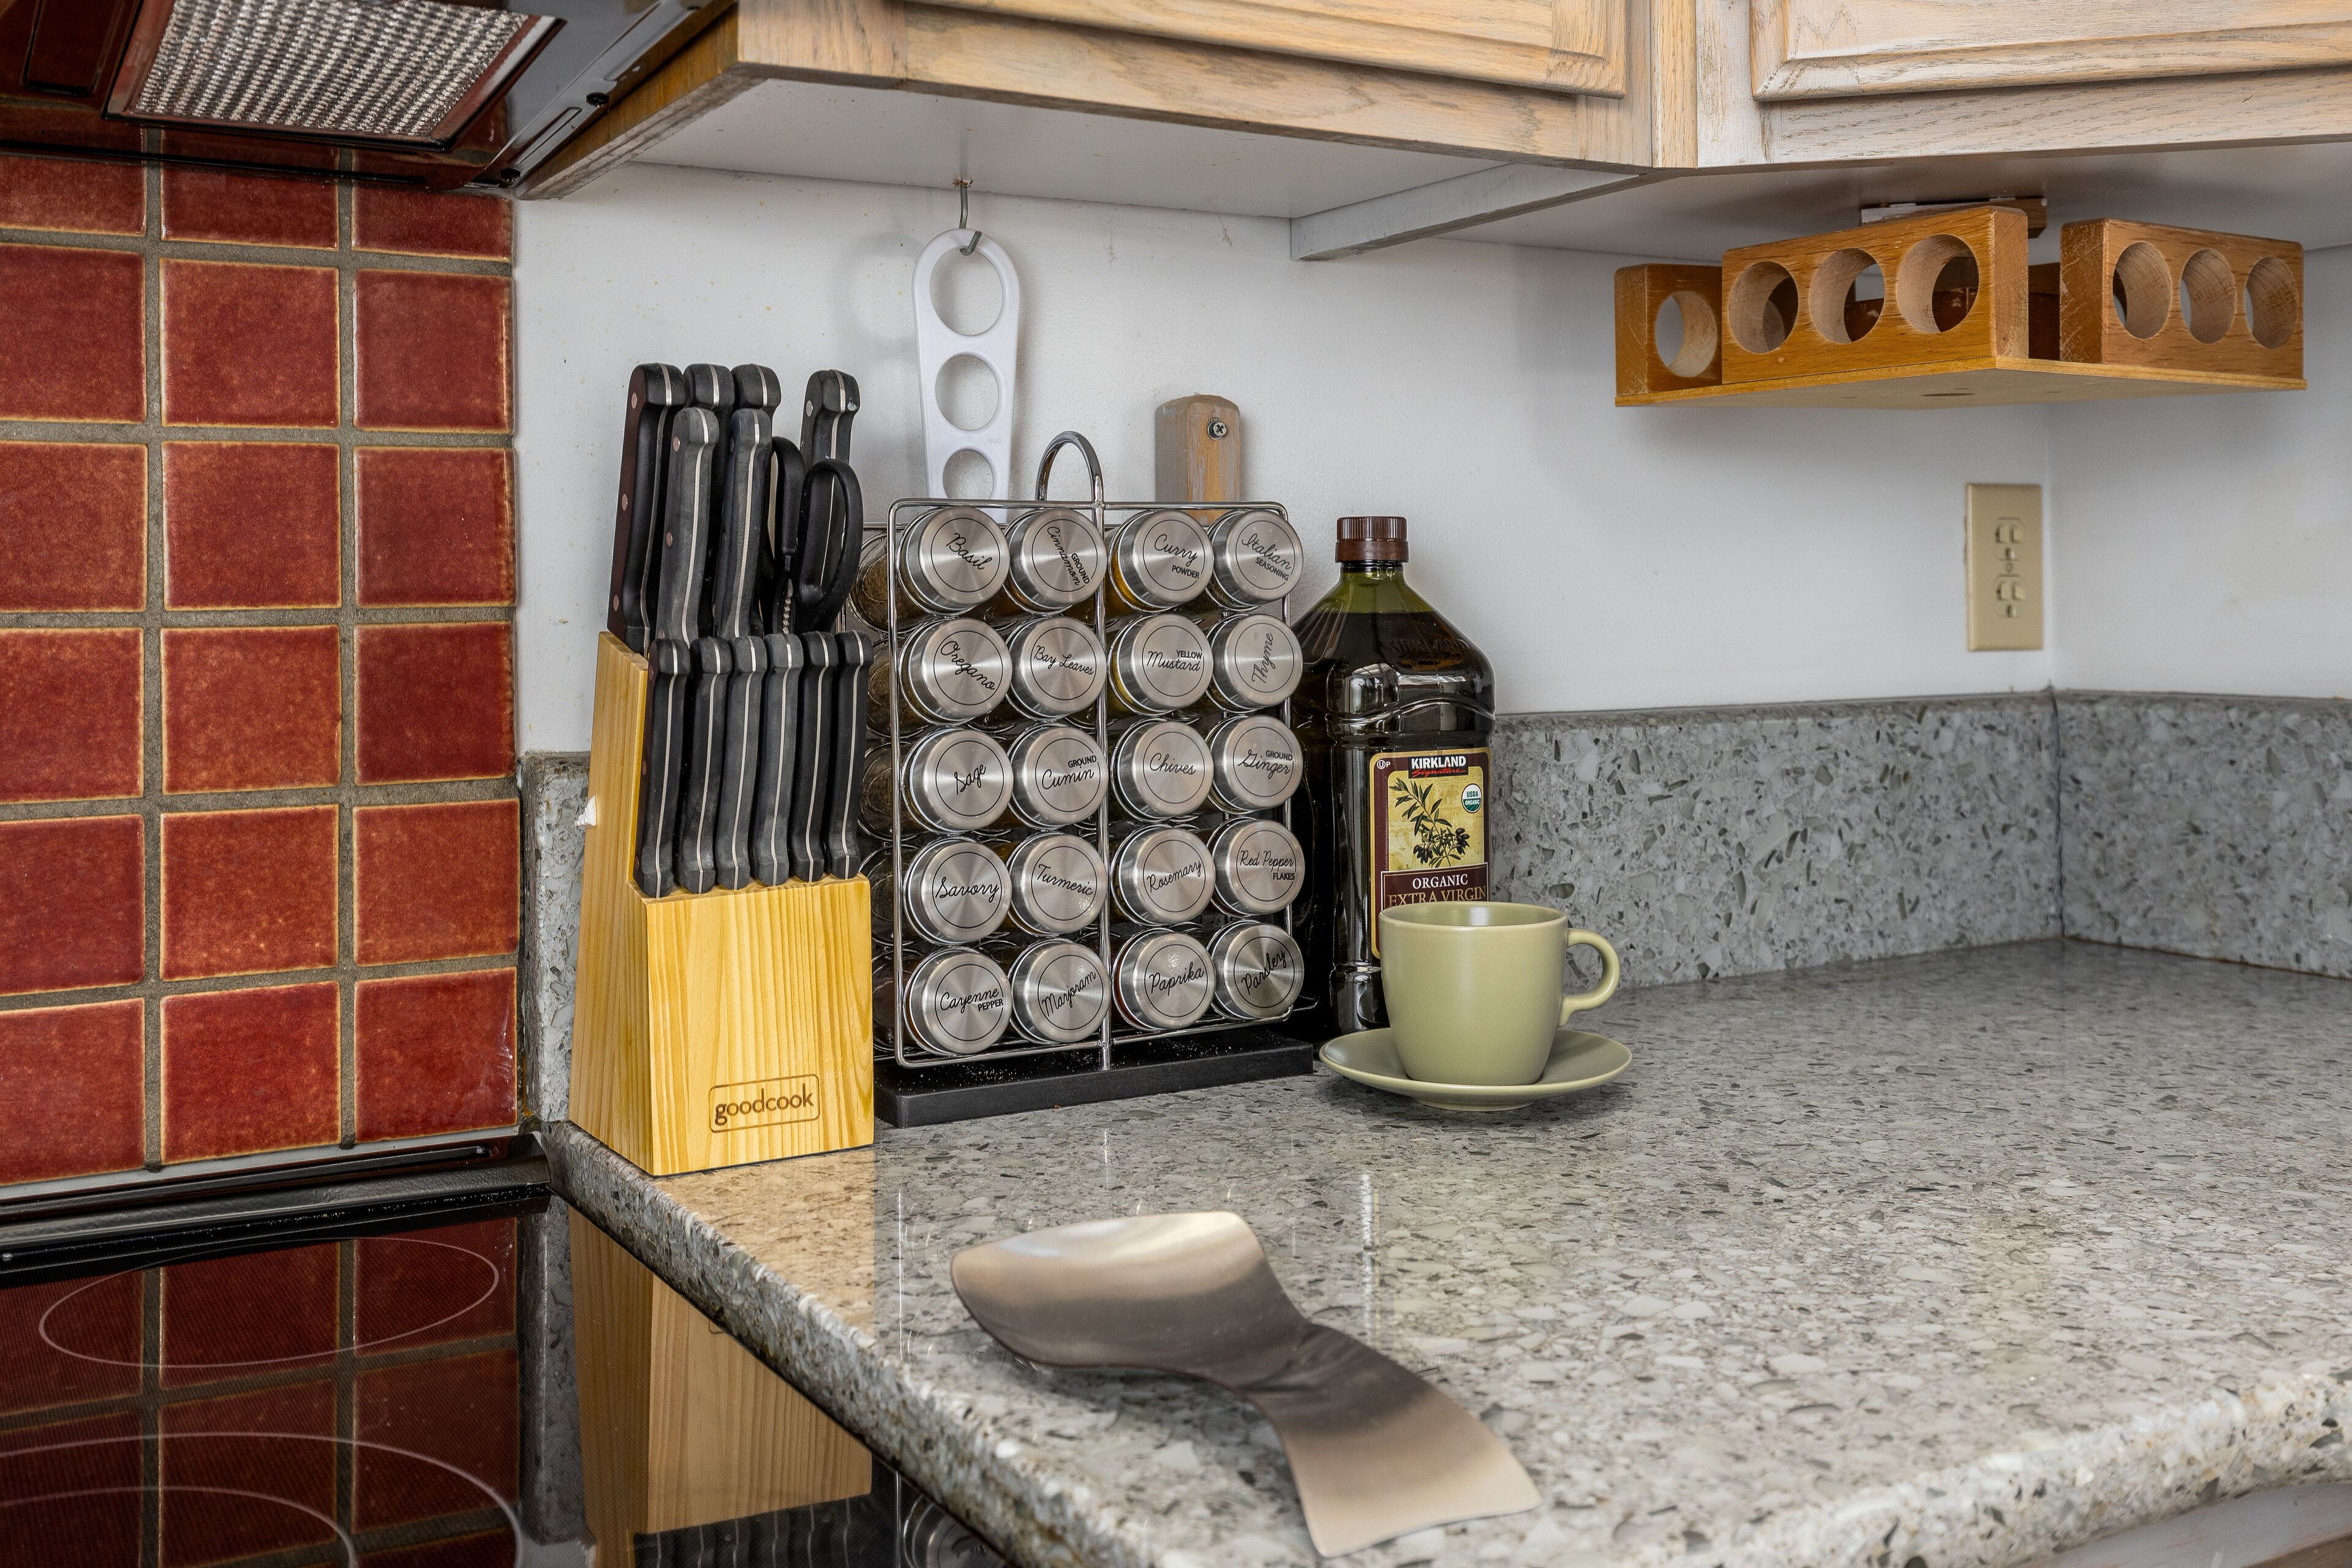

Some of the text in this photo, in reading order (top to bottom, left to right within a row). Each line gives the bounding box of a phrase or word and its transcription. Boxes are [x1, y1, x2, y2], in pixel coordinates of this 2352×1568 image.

[946, 533, 992, 570] Basil
[1047, 526, 1079, 586] Cinnamon
[1154, 534, 1197, 567] Curry
[1242, 533, 1291, 570] Italian
[1071, 553, 1090, 584] GROUND
[1172, 565, 1200, 579] POWDER
[1255, 557, 1289, 581] SEASONING
[940, 641, 995, 690] Oregano
[1034, 645, 1094, 675] Bay Leaves
[1147, 650, 1200, 671] Mustard
[1176, 650, 1202, 659] YELLOW
[1251, 631, 1276, 684] Thyme
[1068, 755, 1096, 768] GROUND
[1150, 752, 1196, 775] Chives
[1238, 749, 1291, 779] Ginger
[1265, 750, 1293, 761] GROUND
[1411, 756, 1466, 769] KIRKLAND
[954, 764, 986, 795] Sage
[1042, 766, 1095, 790] Cumin
[1412, 768, 1466, 778] Signature
[1240, 850, 1294, 872] Red Pepper
[935, 876, 999, 903] Savory
[1037, 864, 1093, 895] Turmeric
[1147, 861, 1202, 893] Rosemary
[1412, 873, 1468, 889] ORGANIC
[1387, 887, 1486, 908] EXTRA VIRGIN
[1149, 962, 1204, 996] Paprika
[1241, 950, 1286, 995] Parsley
[940, 988, 999, 1014] Cayenne
[978, 999, 1003, 1012] PEPPER
[1042, 971, 1096, 1017] Marjoram
[715, 1083, 814, 1126] goodcook
